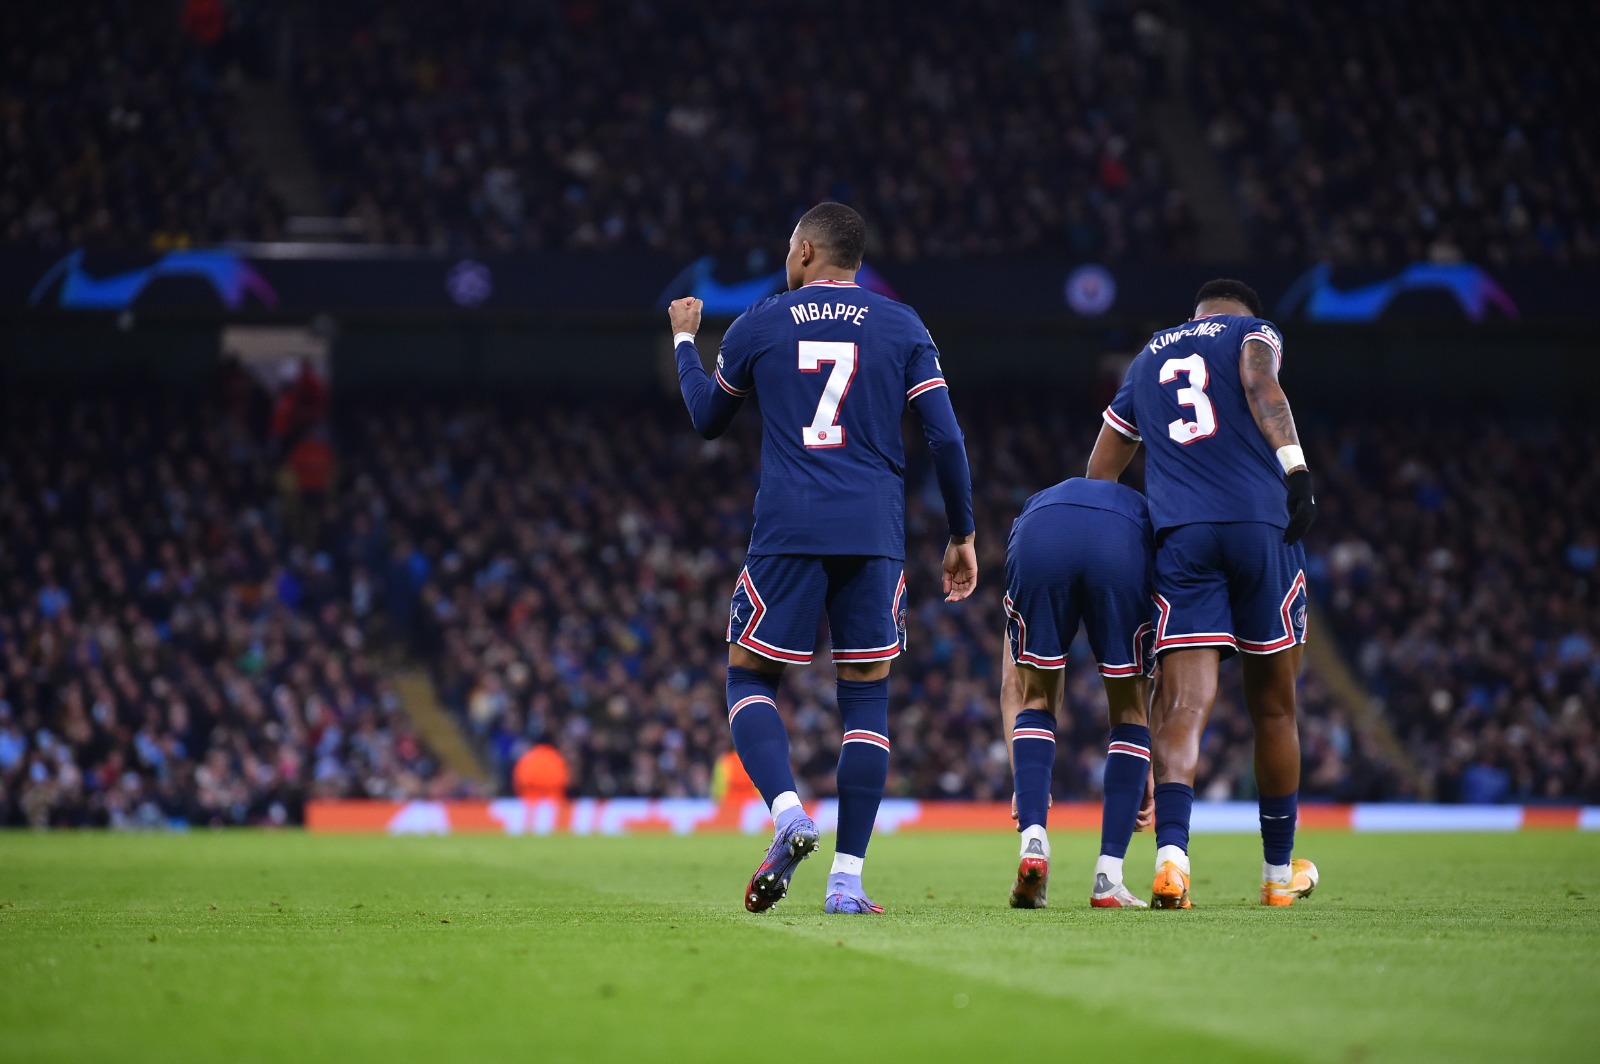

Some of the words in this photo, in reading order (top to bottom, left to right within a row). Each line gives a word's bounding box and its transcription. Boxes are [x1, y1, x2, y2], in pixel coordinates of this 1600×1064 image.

[790, 302, 868, 326] MBAPPÉ
[798, 340, 858, 449] 7
[1159, 353, 1218, 446] 3
